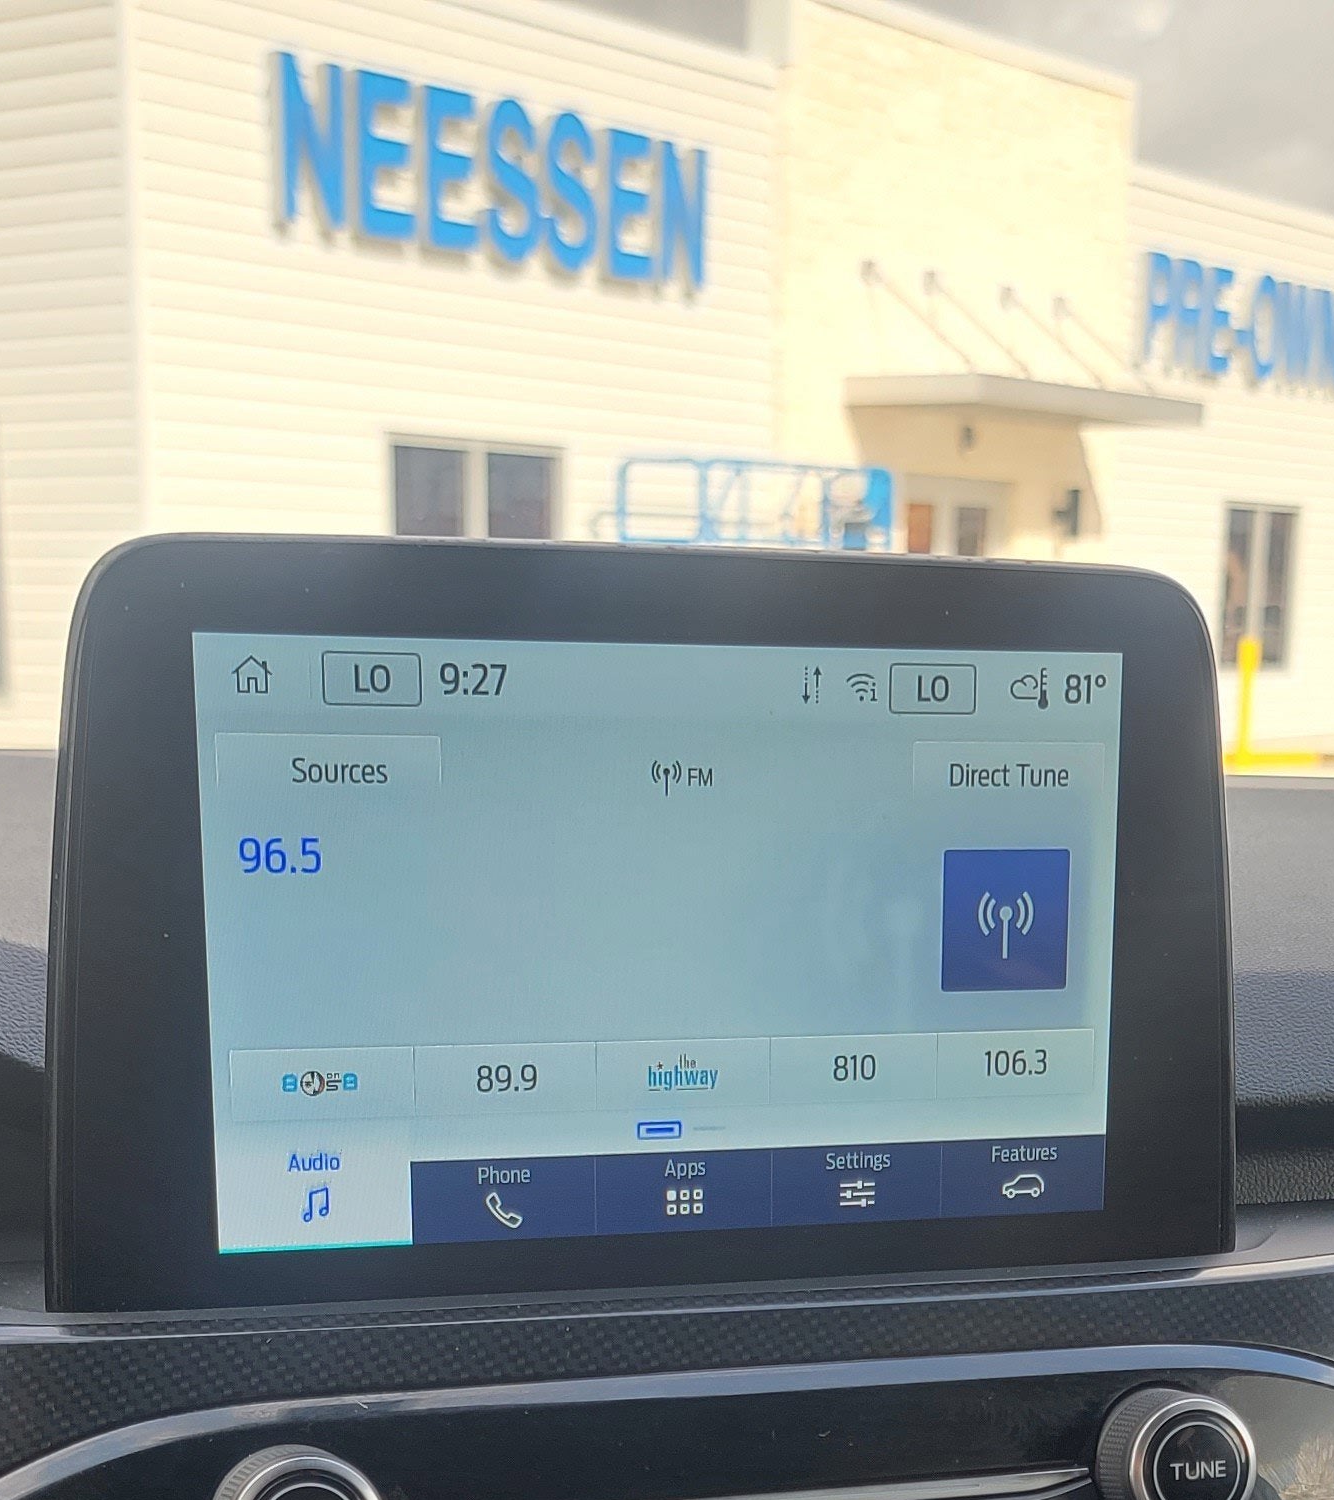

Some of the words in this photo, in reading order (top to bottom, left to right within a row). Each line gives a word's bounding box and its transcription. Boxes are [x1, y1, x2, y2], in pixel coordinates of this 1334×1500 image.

[275, 50, 709, 292] NEESSEN
[353, 663, 392, 695] LO
[439, 663, 508, 698] 9:27
[916, 675, 950, 703] LO
[1063, 674, 1107, 706] 81°
[291, 757, 389, 785] Sources
[686, 767, 714, 788] FM
[949, 761, 1009, 789] Direct
[1015, 763, 1070, 789] Tune
[237, 836, 323, 876] 96.5
[678, 1053, 697, 1069] the
[832, 1052, 877, 1082] 810
[983, 1048, 1049, 1077] 106.3
[475, 1063, 538, 1093] 89.9
[647, 1062, 719, 1090] highway
[287, 1152, 340, 1174] Audio
[825, 1151, 891, 1171] Settings
[990, 1143, 1058, 1164] Features
[476, 1165, 531, 1187] Phone
[664, 1158, 707, 1181] Apps
[1170, 1460, 1227, 1482] TUNE
